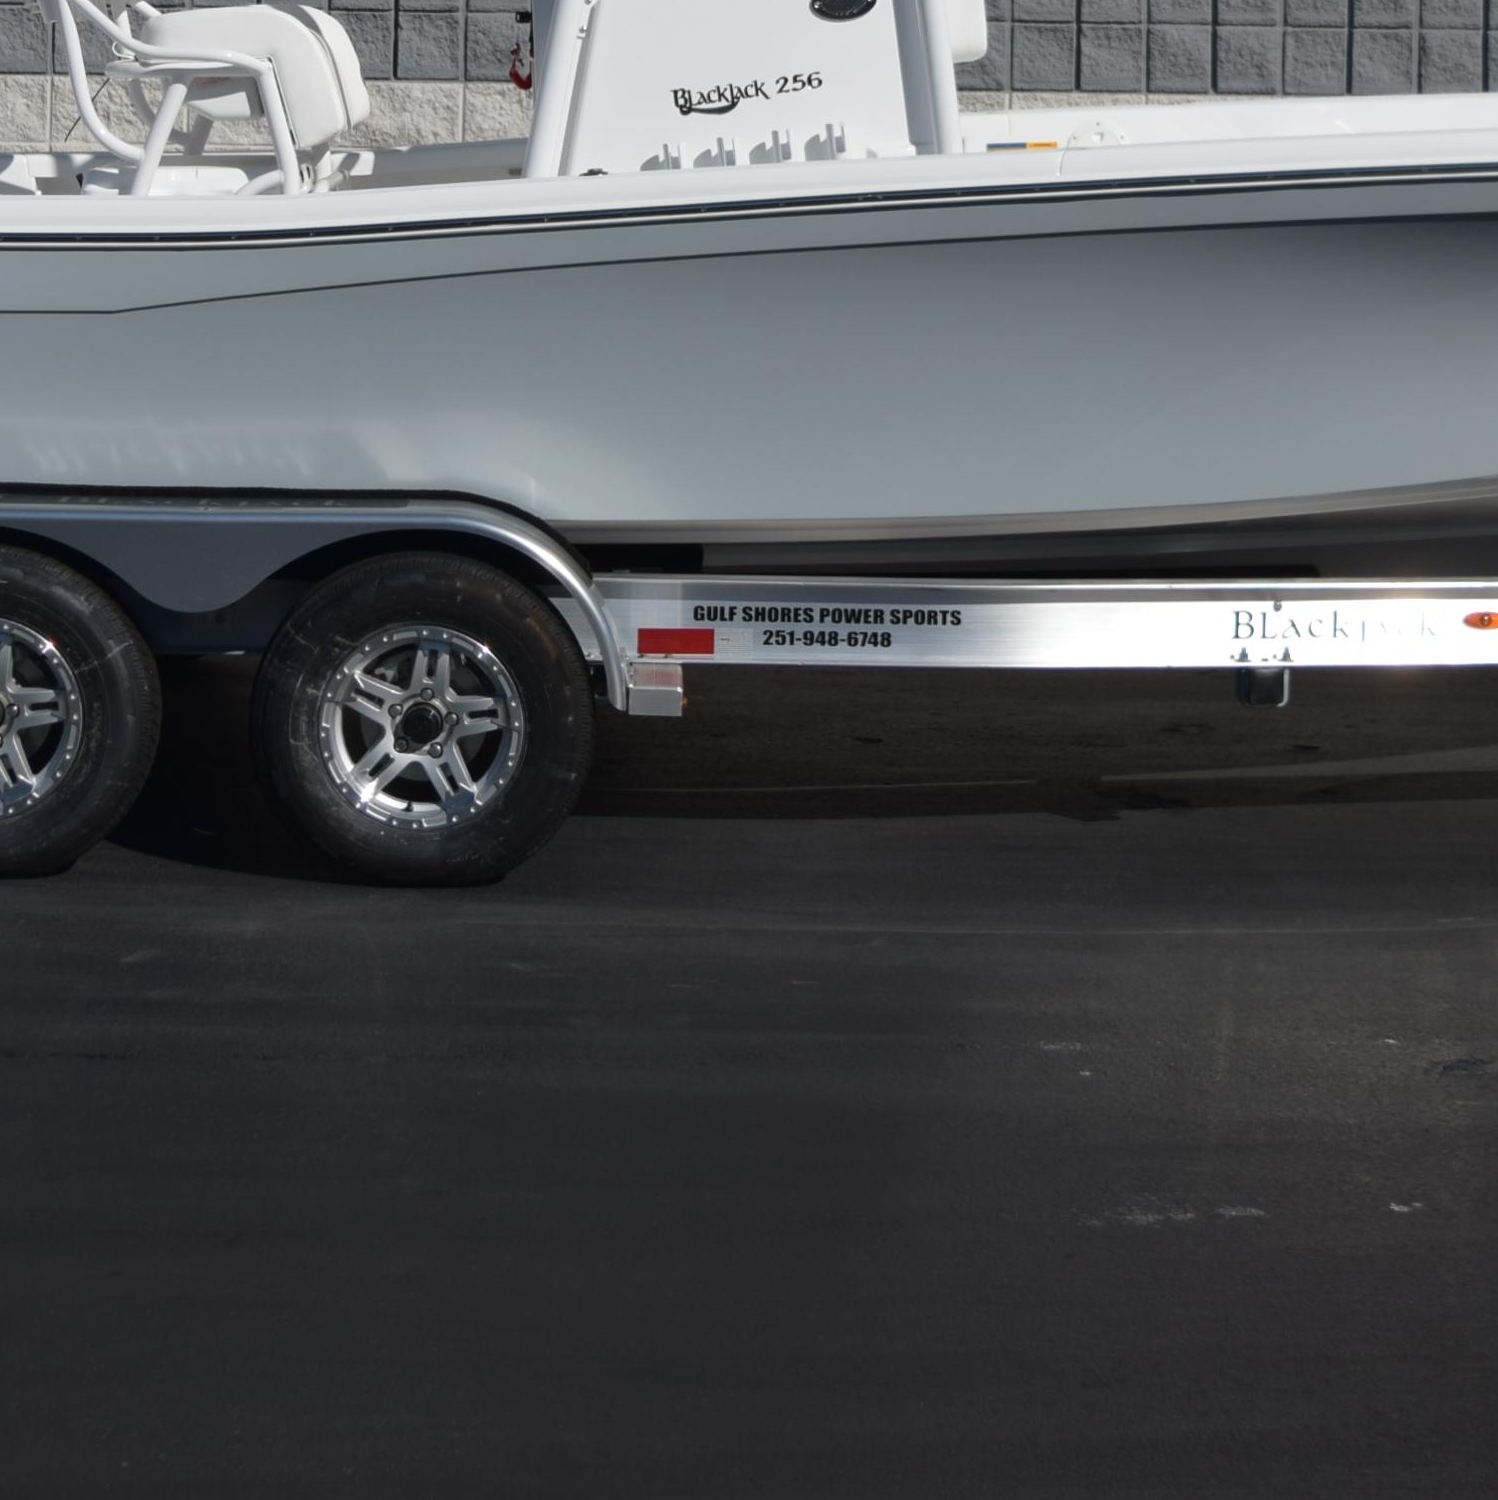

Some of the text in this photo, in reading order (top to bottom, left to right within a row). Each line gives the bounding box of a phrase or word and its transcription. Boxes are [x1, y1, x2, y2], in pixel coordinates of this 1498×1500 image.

[775, 71, 823, 94] 256
[693, 605, 962, 626] GULF SHORES POWER SPORTS
[762, 629, 892, 648] 251-948-6748
